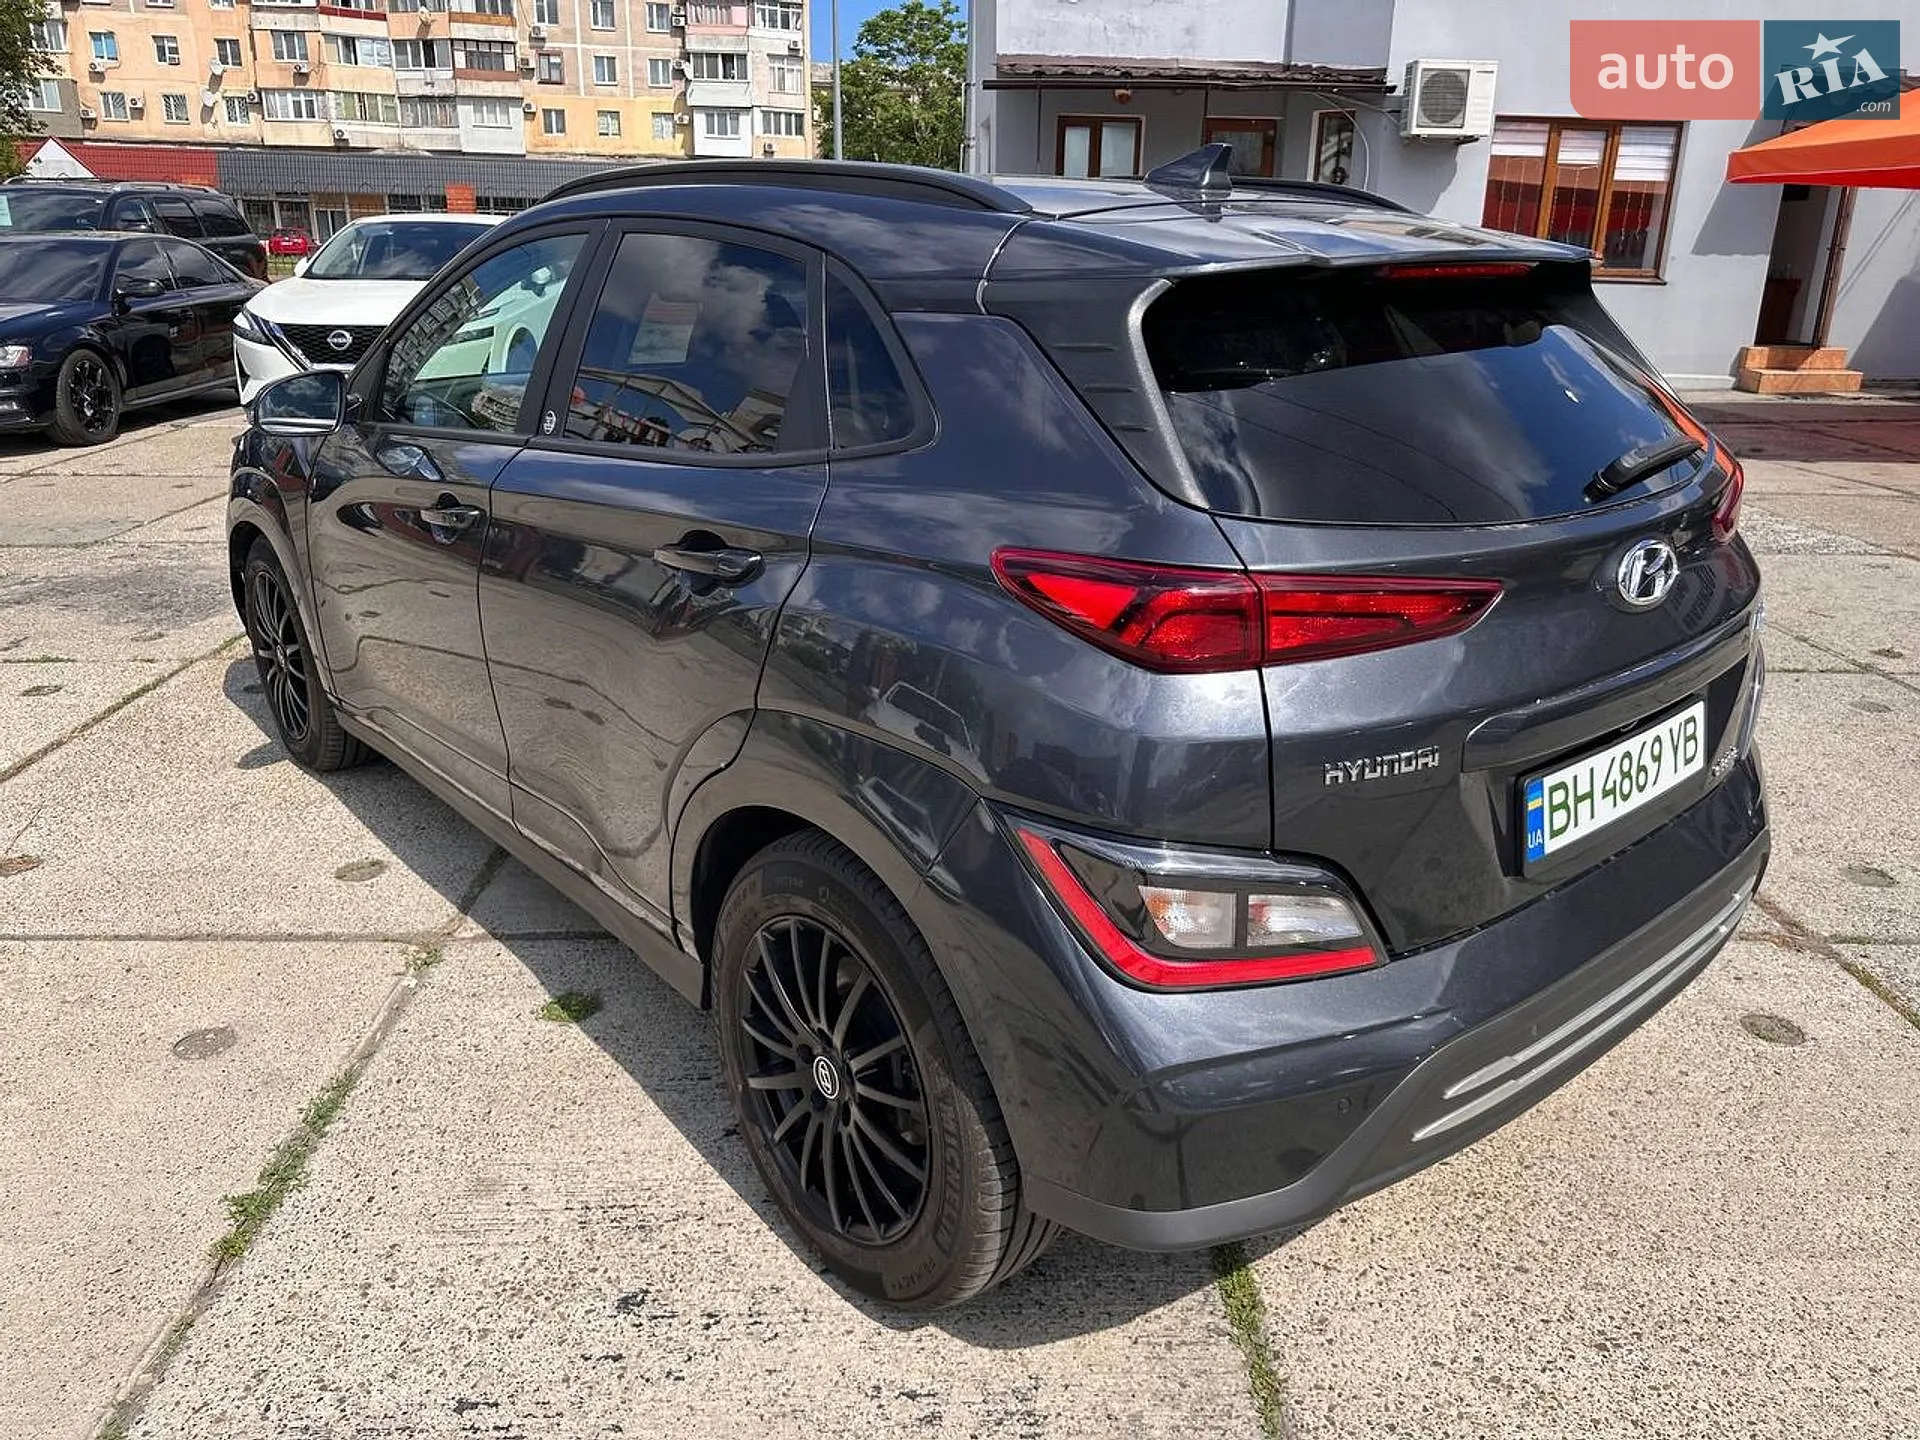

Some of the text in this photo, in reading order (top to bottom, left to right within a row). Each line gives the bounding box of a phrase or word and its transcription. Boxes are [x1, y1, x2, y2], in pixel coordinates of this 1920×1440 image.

[1324, 745, 1440, 786] HYUNDAI
[1548, 766, 1595, 840] BH
[1601, 734, 1663, 807] 4869
[1669, 715, 1698, 775] YB
[1527, 832, 1544, 849] UA
